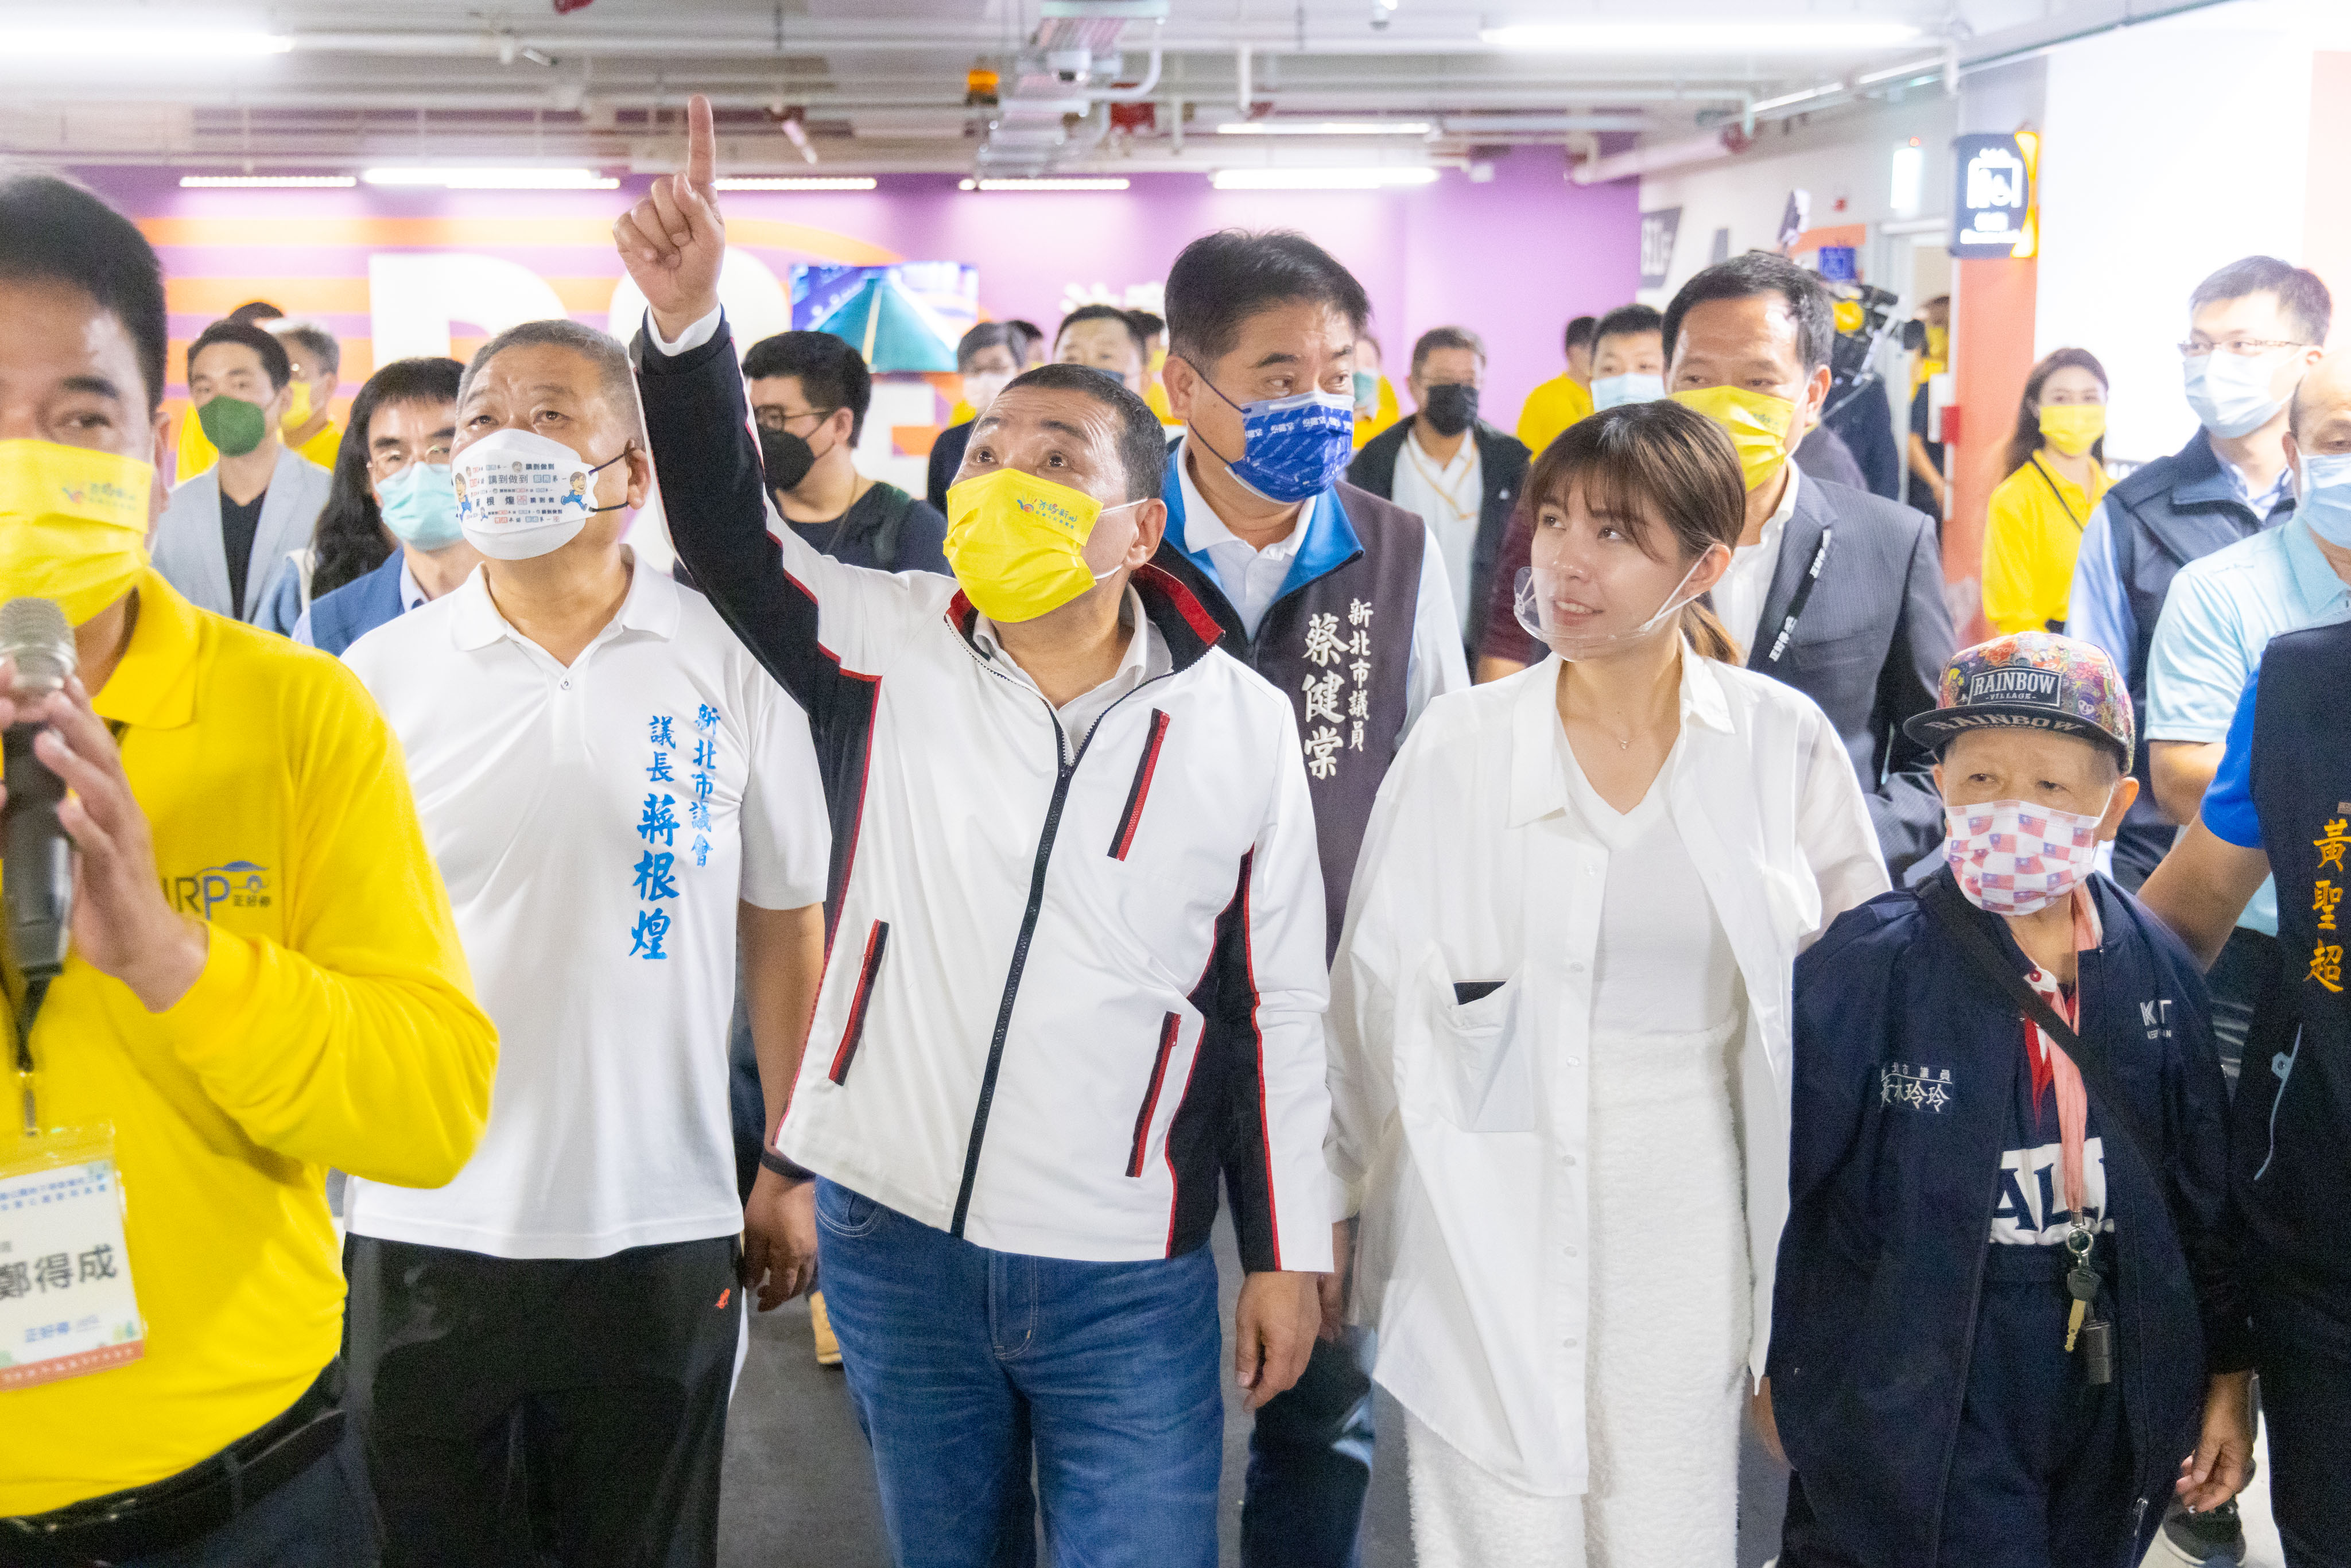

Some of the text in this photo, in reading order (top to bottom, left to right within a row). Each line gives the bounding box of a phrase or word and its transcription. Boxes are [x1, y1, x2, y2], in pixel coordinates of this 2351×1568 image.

[488, 474, 528, 484] 講到做到
[1302, 612, 1350, 780] 蔡健棠
[1348, 598, 1374, 752] 新北市議員
[1924, 714, 2084, 731] RAINBOW
[1973, 673, 2056, 696] RAINBOW
[629, 715, 681, 960] 議長 蔣根煌
[688, 703, 721, 868] 新北市議會
[2303, 818, 2351, 993] 黃聖超
[1881, 1062, 1950, 1082] 北市議員
